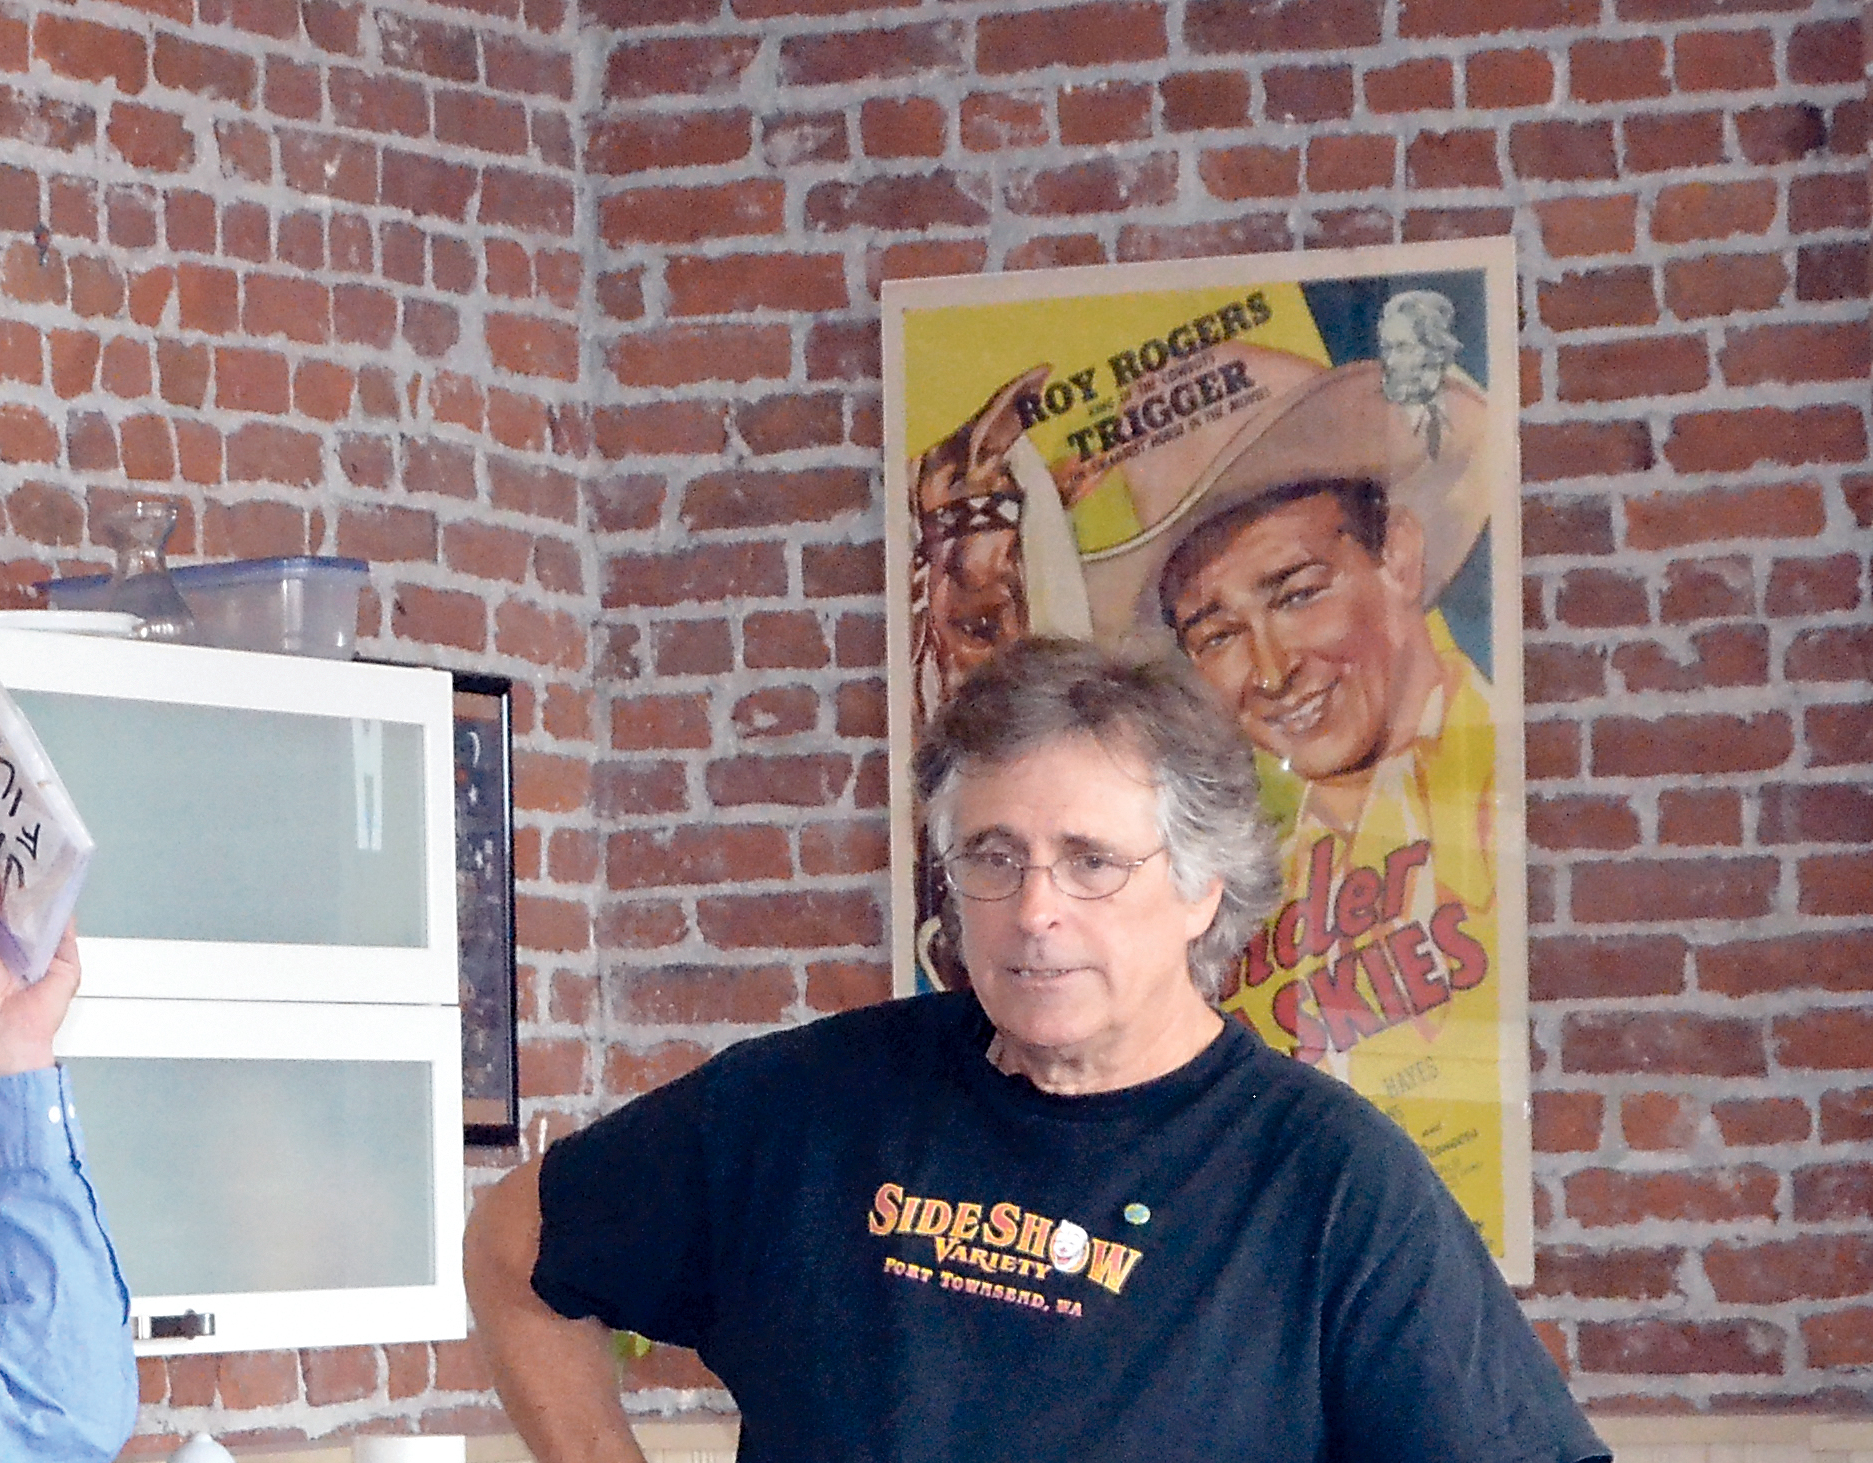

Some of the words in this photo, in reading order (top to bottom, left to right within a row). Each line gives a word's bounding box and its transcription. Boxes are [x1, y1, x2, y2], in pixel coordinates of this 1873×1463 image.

[1015, 367, 1097, 429] ROY
[1108, 291, 1271, 387] ROGERS
[1067, 359, 1256, 463] TRIGGER
[1221, 834, 1431, 1001] nder
[1272, 901, 1490, 1064] SKIES
[868, 1182, 1143, 1295] SIDESHOW
[883, 1256, 934, 1283] PORT
[940, 1270, 1050, 1313] TOWNSEND,
[1055, 1298, 1084, 1318] WA
[934, 1235, 1054, 1281] VARIETY
